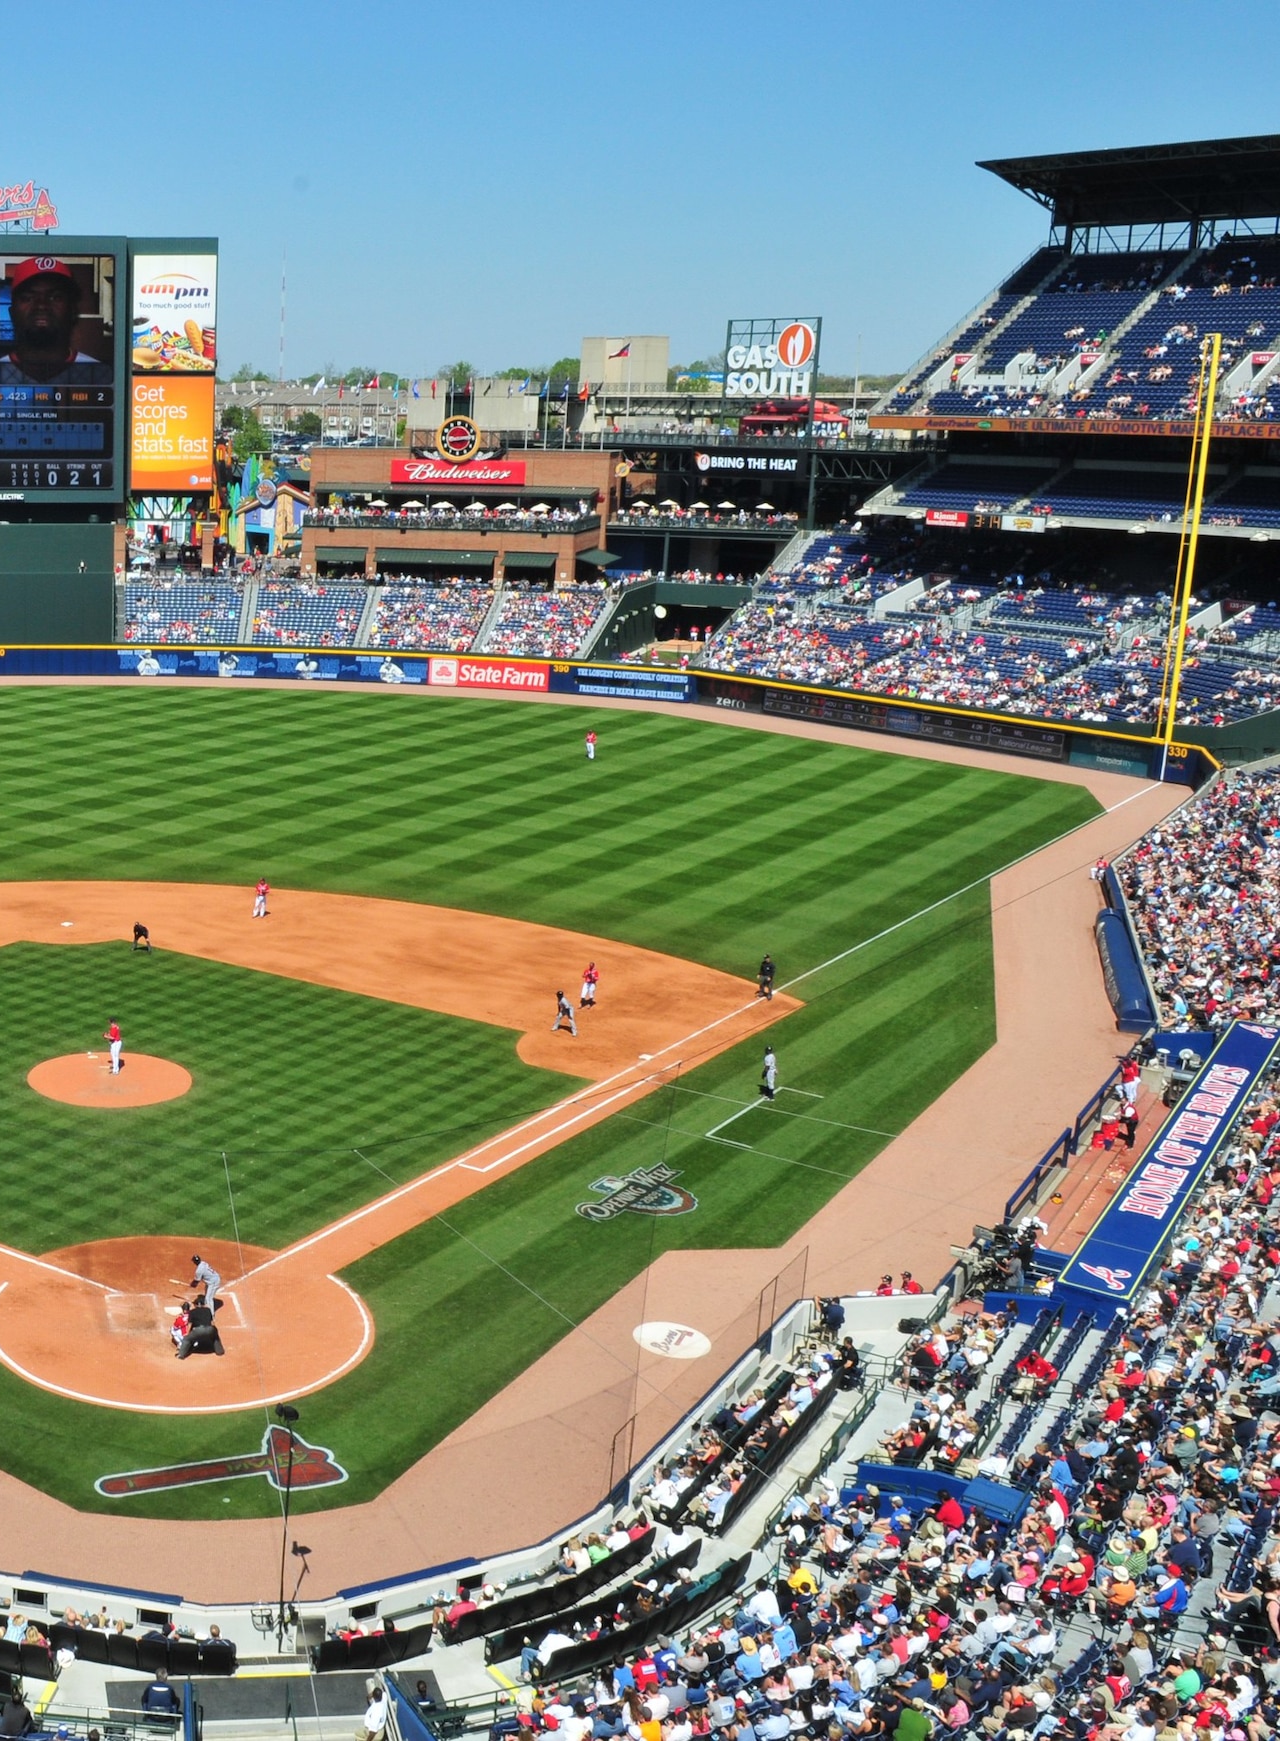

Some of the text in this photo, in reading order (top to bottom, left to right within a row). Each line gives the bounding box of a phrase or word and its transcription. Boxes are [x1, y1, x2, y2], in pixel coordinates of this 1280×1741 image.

[140, 284, 209, 300] ampm
[173, 302, 192, 310] good
[727, 345, 778, 369] GAS
[725, 371, 811, 396] SOUTH
[55, 393, 62, 401] 0
[97, 393, 104, 401] 2
[134, 384, 165, 402] Get
[134, 405, 188, 419] scores
[134, 419, 166, 436] and
[1008, 420, 1029, 430] THE
[1032, 421, 1085, 432] ULTIMATE
[1088, 422, 1165, 434] AUTOMOTIVE
[134, 435, 208, 453] stats fast
[404, 462, 511, 480] Budweiser
[711, 456, 798, 471] BRING THE HEAT
[48, 471, 100, 486] 0 2 1
[459, 663, 545, 687] State Farm
[553, 664, 570, 673] 390
[715, 696, 746, 709] zero
[1167, 746, 1188, 759] 330
[1118, 1063, 1251, 1221] HOME OF THE BRAVES
[580, 1166, 676, 1219] OPENING WEEK
